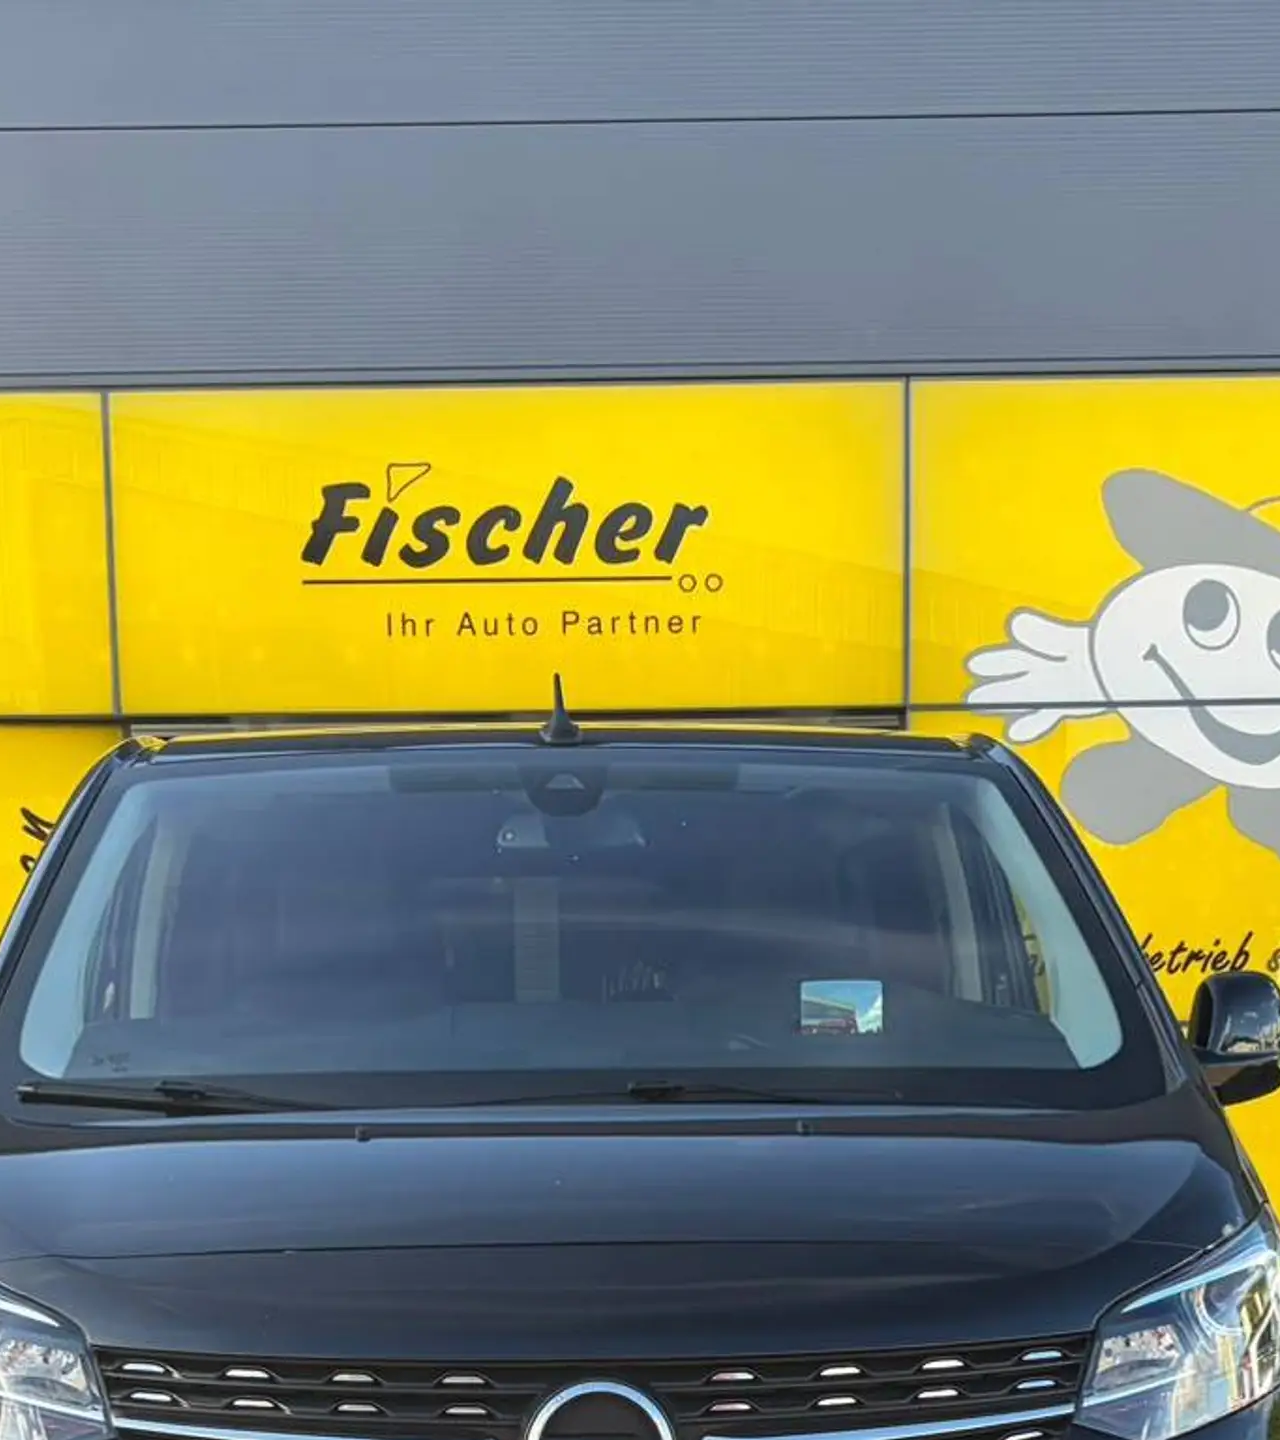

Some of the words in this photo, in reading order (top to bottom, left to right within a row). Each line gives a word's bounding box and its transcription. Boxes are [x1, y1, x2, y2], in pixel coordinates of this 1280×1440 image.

[301, 463, 709, 569] Fischer
[386, 612, 434, 638] Ihr
[456, 611, 539, 637] Auto
[561, 609, 702, 636] Partner
